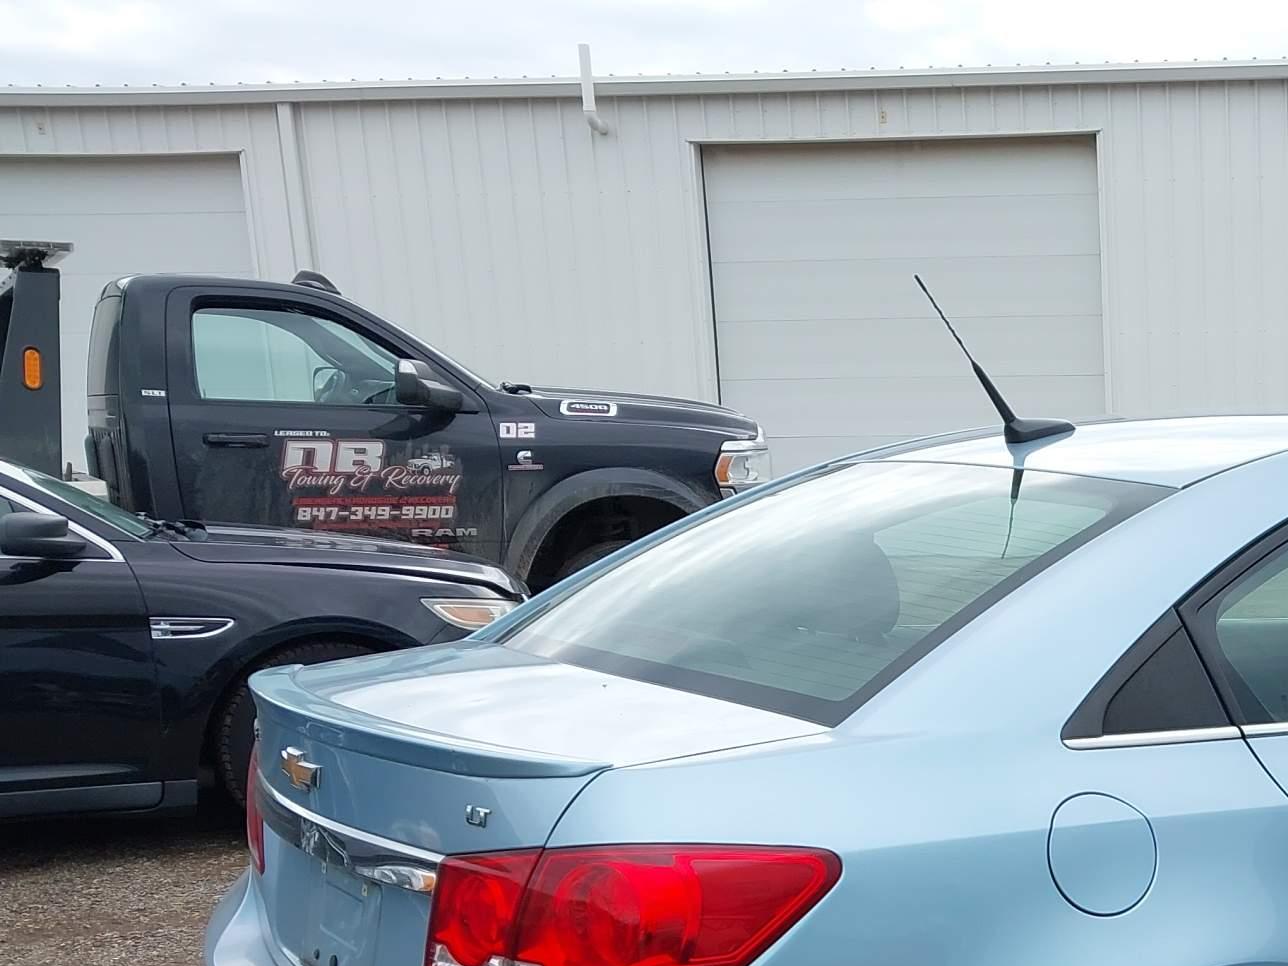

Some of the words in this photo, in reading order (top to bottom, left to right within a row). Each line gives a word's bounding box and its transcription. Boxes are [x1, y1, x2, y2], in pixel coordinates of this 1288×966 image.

[282, 465, 345, 494] Towing
[381, 465, 461, 493] Recovery
[297, 505, 454, 521] 847-349-9900
[411, 528, 477, 537] RAM
[465, 805, 491, 828] LT
